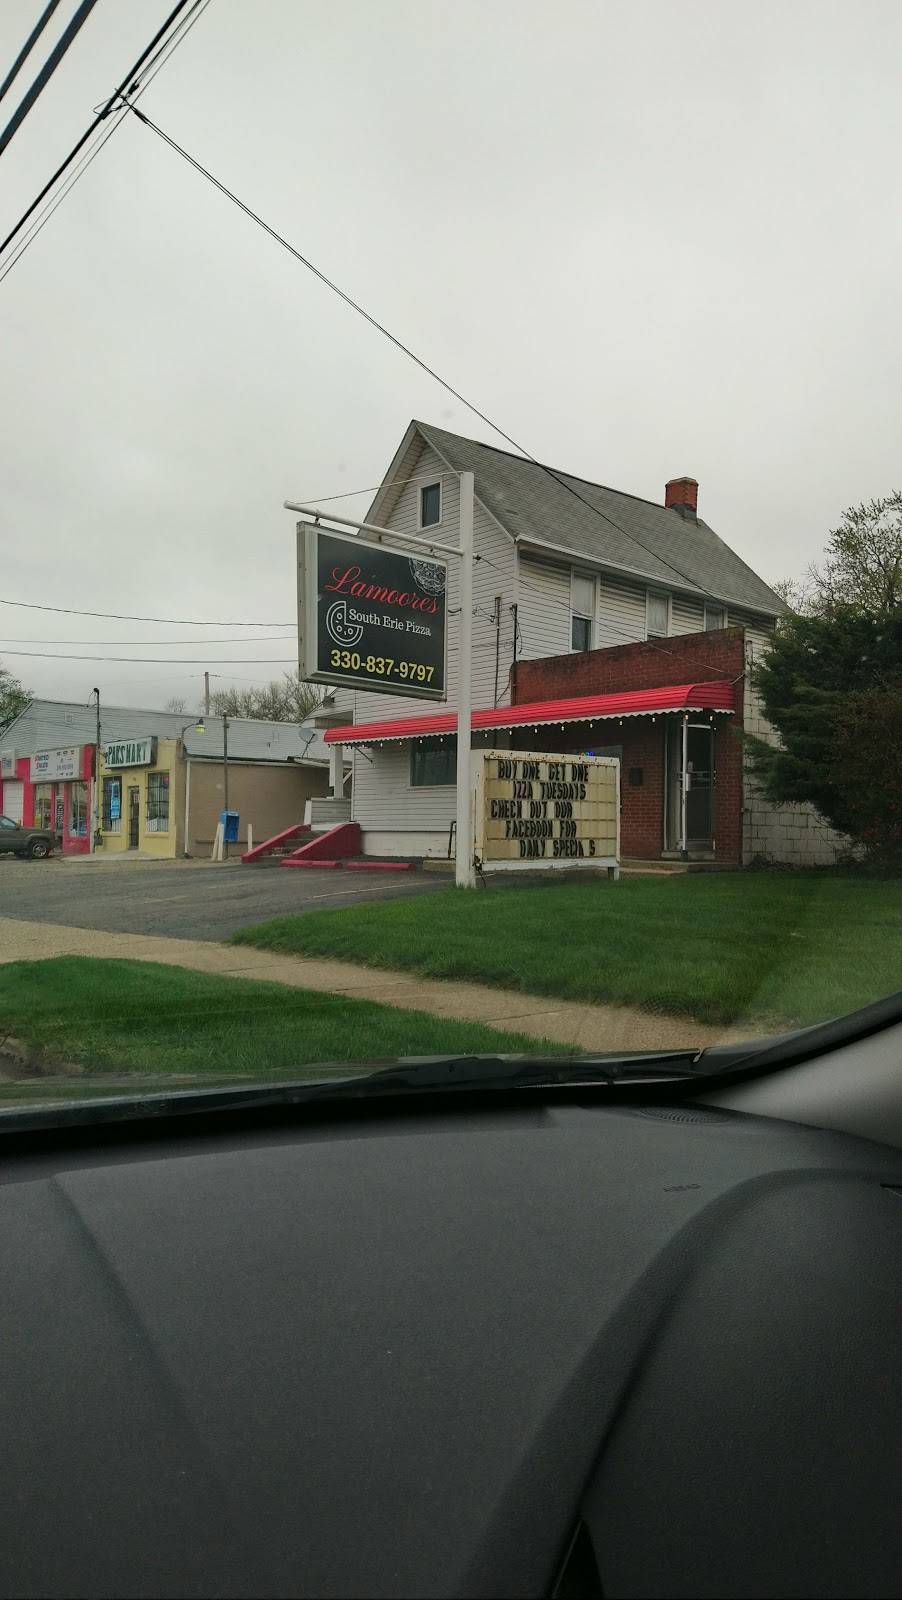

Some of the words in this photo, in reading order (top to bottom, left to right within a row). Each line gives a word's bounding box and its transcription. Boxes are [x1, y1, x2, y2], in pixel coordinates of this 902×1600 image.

[349, 608, 381, 626] South
[382, 615, 404, 631] Erie
[406, 620, 432, 636] Pizza
[330, 649, 434, 682] 330-837-9797
[497, 760, 518, 779] BUY
[522, 762, 540, 779] ONE
[548, 763, 566, 780] GET
[571, 763, 589, 782] ONE
[540, 782, 586, 800] TUESDAYS
[490, 799, 522, 818] CHECK
[530, 801, 547, 818] OUT
[555, 801, 573, 818] OUR
[505, 820, 553, 838] FACEBOOK
[560, 820, 577, 838] FOR
[520, 839, 546, 857] DAILY
